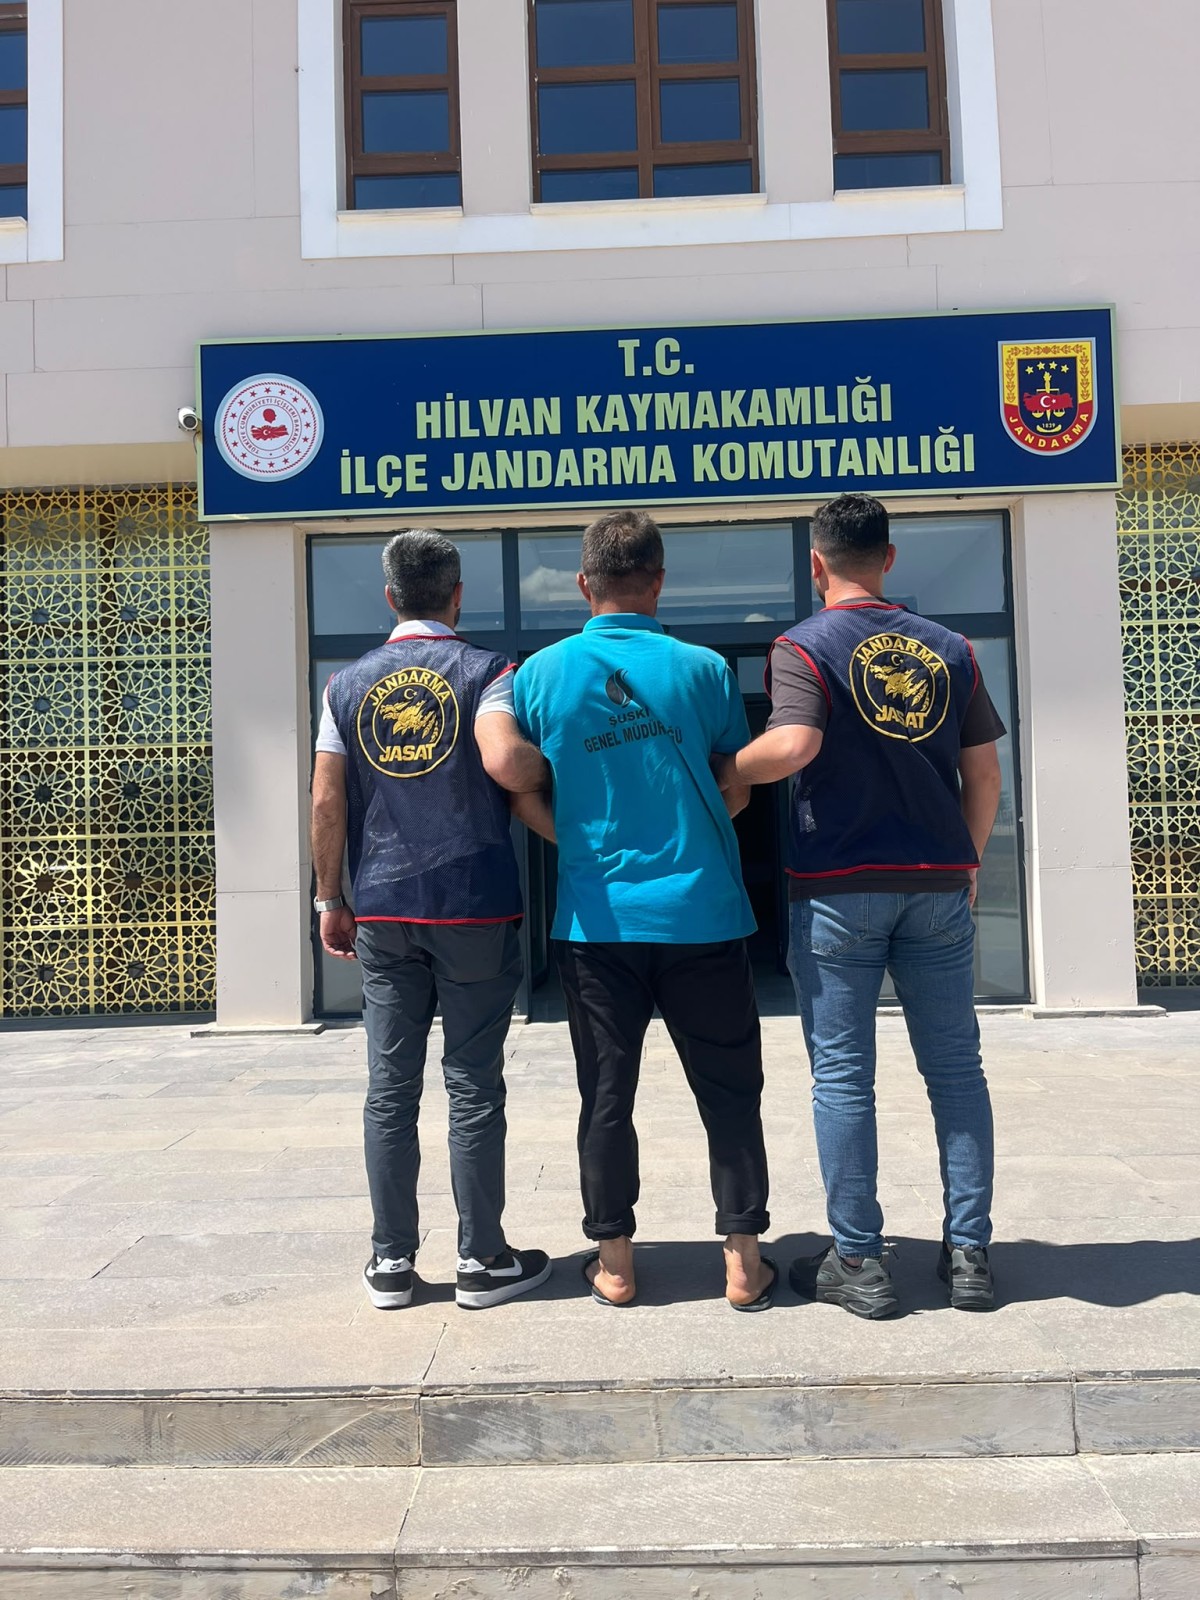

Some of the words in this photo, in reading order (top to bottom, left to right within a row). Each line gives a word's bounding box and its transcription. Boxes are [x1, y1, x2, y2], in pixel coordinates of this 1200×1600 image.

[618, 338, 694, 377] T.C.
[416, 393, 561, 439] HİLVAN
[576, 375, 893, 433] KAYMAKAMLIĞI
[1009, 413, 1089, 448] JANDARMA
[340, 449, 428, 498] İLÇE
[441, 445, 677, 491] JANDARMA
[693, 425, 975, 482] KOMUTANLIĞI
[856, 636, 943, 675] JANDARMA
[368, 670, 451, 707] JANDARMA
[875, 704, 928, 729] JASAT
[379, 743, 437, 763] JASAT
[584, 731, 622, 753] GENEL
